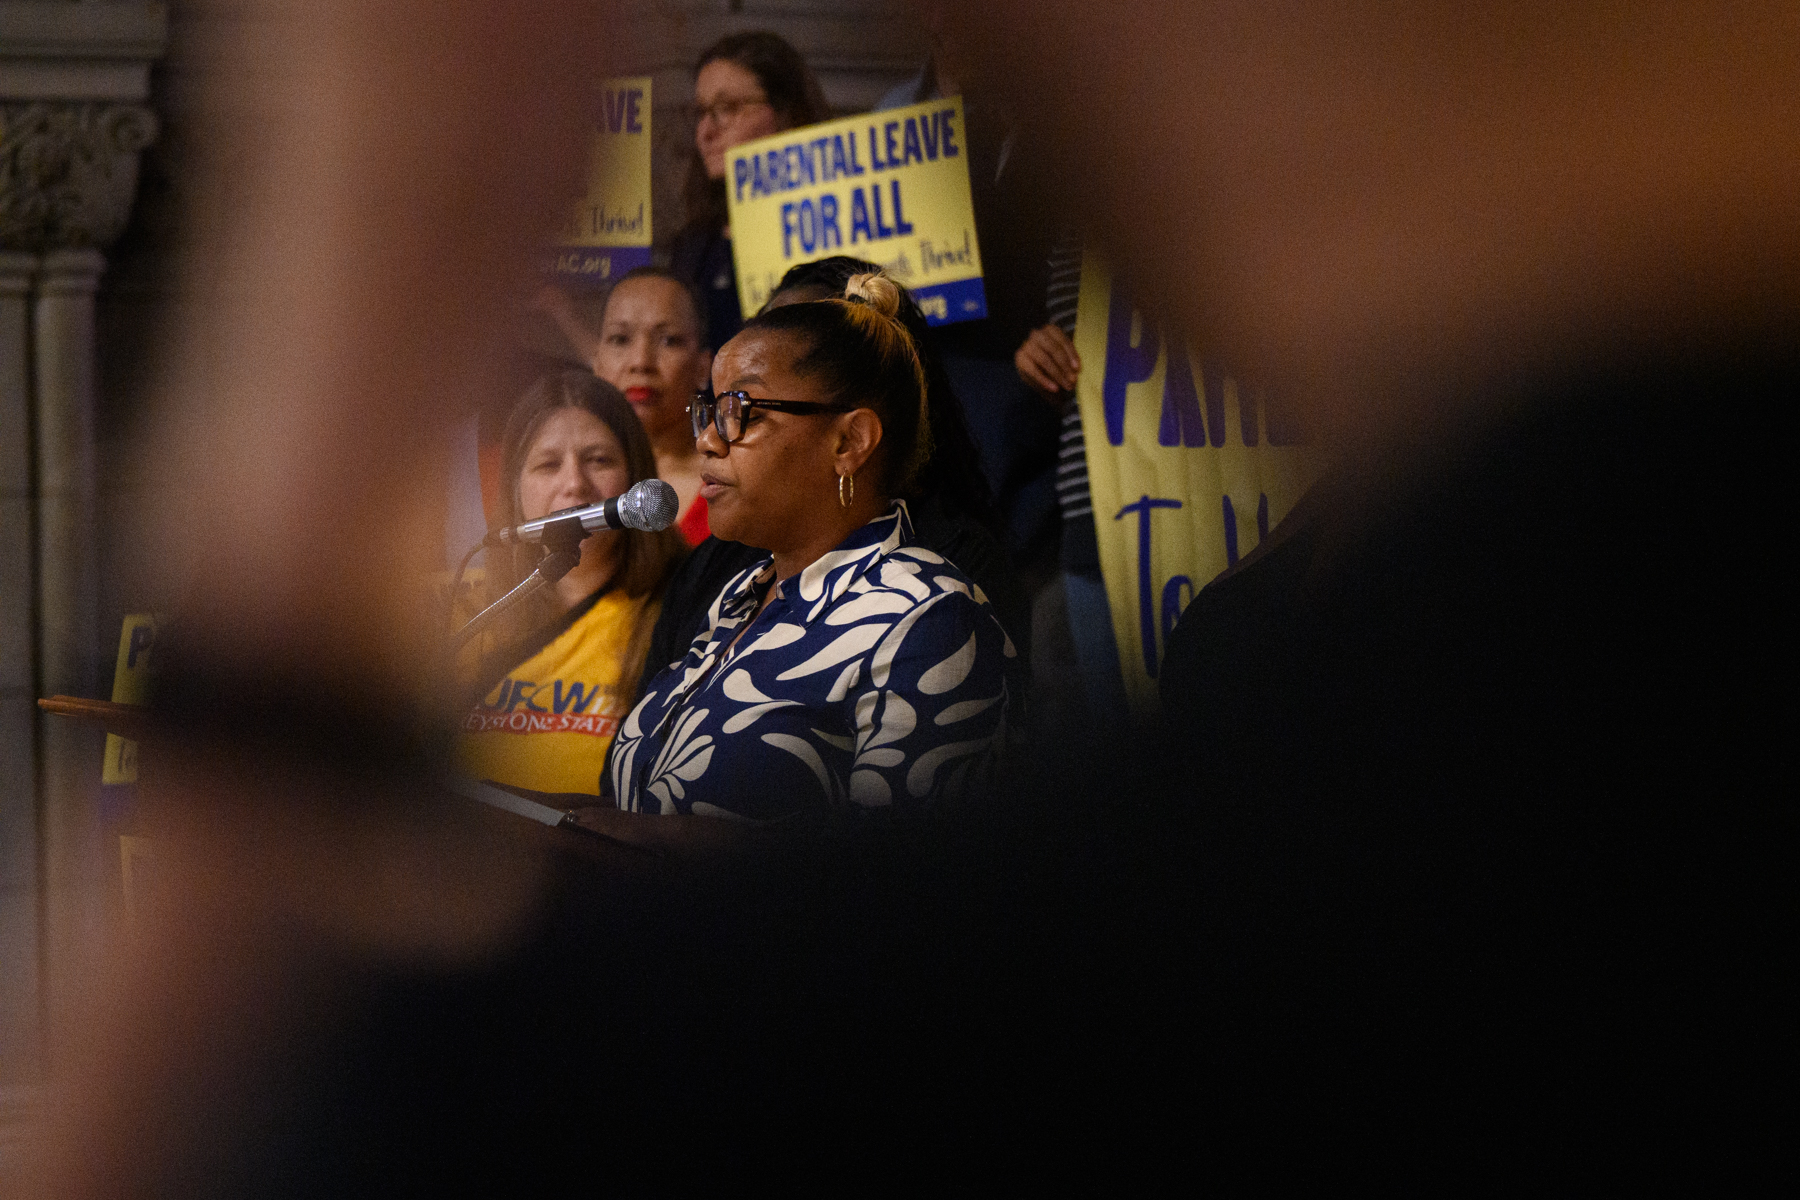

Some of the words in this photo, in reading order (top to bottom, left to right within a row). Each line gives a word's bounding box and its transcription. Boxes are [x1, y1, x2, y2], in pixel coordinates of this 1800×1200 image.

[597, 88, 643, 134] VE
[734, 132, 865, 204] PARENTAL
[868, 108, 958, 172] LEAVE
[781, 193, 842, 260] FOR
[851, 179, 914, 246] ALL
[462, 712, 553, 731] EYSTONE
